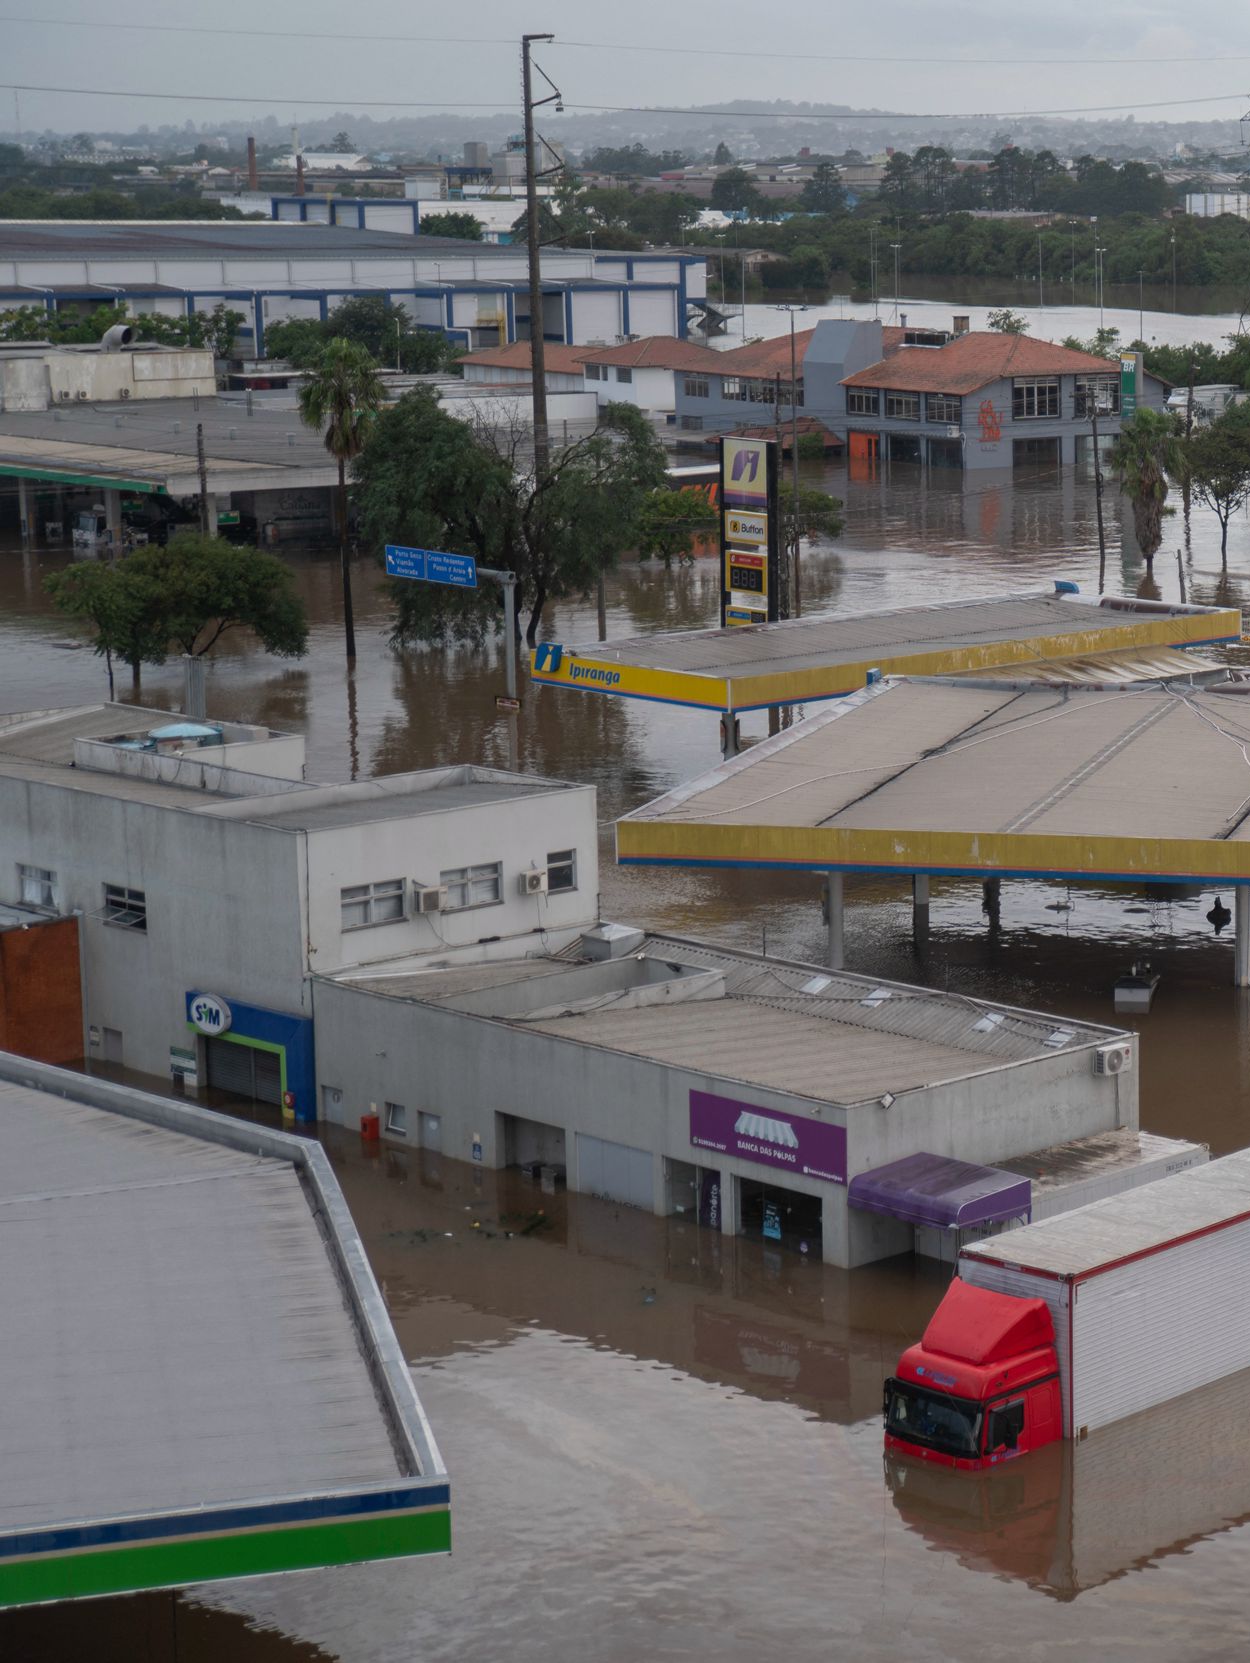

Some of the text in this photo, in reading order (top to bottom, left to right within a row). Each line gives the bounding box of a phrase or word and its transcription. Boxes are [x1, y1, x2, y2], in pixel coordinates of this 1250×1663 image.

[1123, 362, 1135, 372] BR
[569, 662, 621, 686] Ipiranga
[737, 1140, 759, 1153] BANCA
[759, 1146, 773, 1157] DAS
